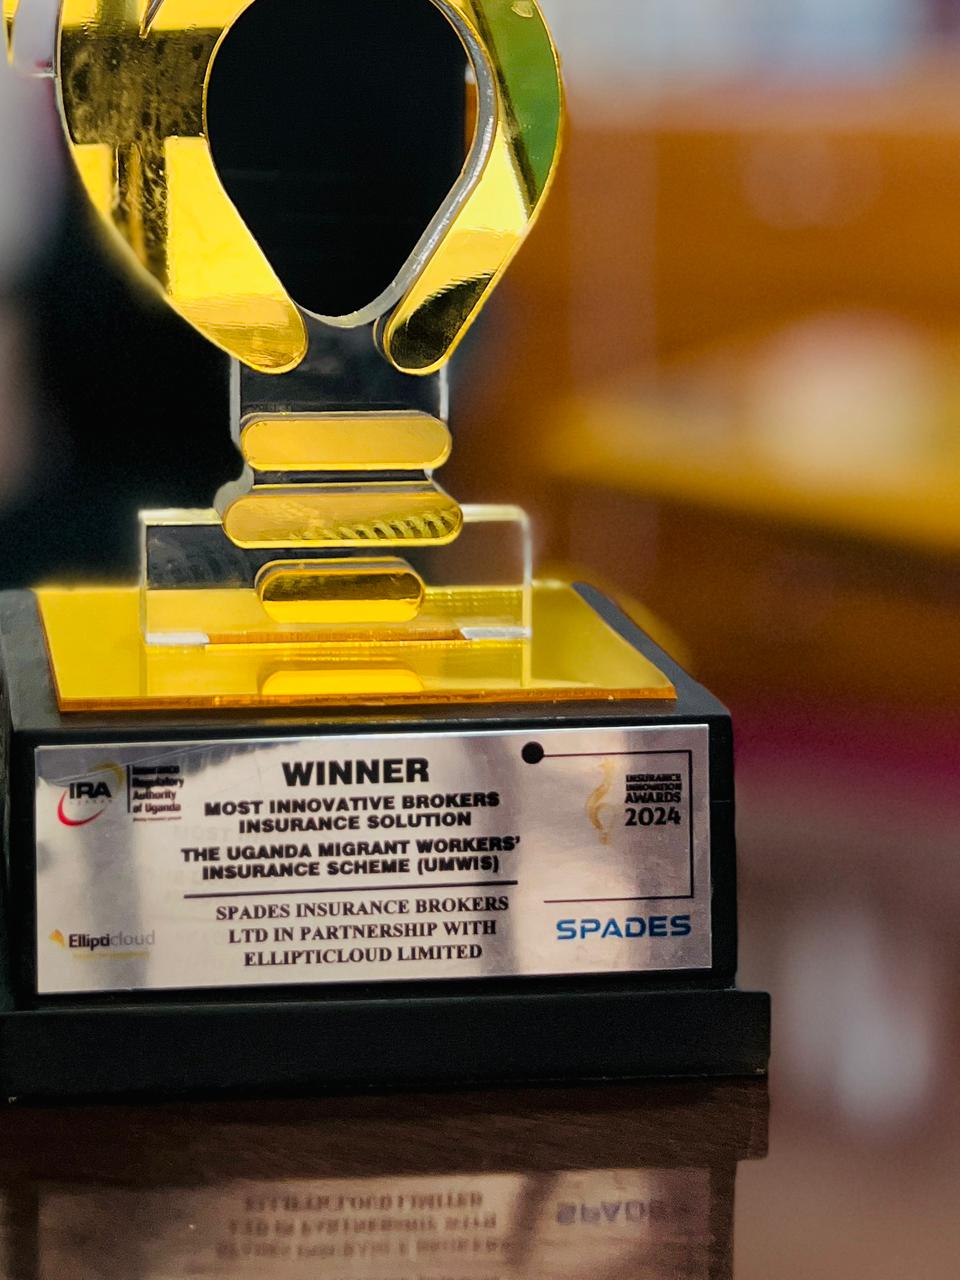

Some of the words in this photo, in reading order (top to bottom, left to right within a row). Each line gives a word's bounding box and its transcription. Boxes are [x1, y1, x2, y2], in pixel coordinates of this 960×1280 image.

[282, 758, 429, 786] WINNER
[145, 803, 182, 814] Uganda
[204, 800, 263, 816] MOST
[270, 796, 394, 814] INNOVATIVE
[402, 792, 500, 810] BROKERS
[624, 792, 682, 803] AWARDS
[239, 815, 360, 834] INSURANCE
[367, 812, 472, 829] SOLUTION
[624, 806, 680, 826] 2024
[180, 846, 220, 862] THE
[227, 843, 312, 860] UGANDA
[318, 840, 410, 857] MIGRANT
[202, 862, 320, 880] INSURANCE
[327, 858, 410, 876] SCHEME
[418, 855, 500, 876] (UMWIS)
[216, 904, 290, 920] SPADES
[296, 899, 410, 918] INSURANCE
[415, 896, 509, 914] BROKERS
[228, 928, 268, 944] LTD
[274, 927, 294, 942] IN
[300, 922, 438, 940] PARTNERSHIP
[442, 920, 496, 936] WITH
[556, 914, 691, 940] SPADES
[69, 929, 156, 951] Ellipticloud
[244, 947, 392, 967] ELLIPTICLOUD
[397, 944, 483, 960] LIMITED
